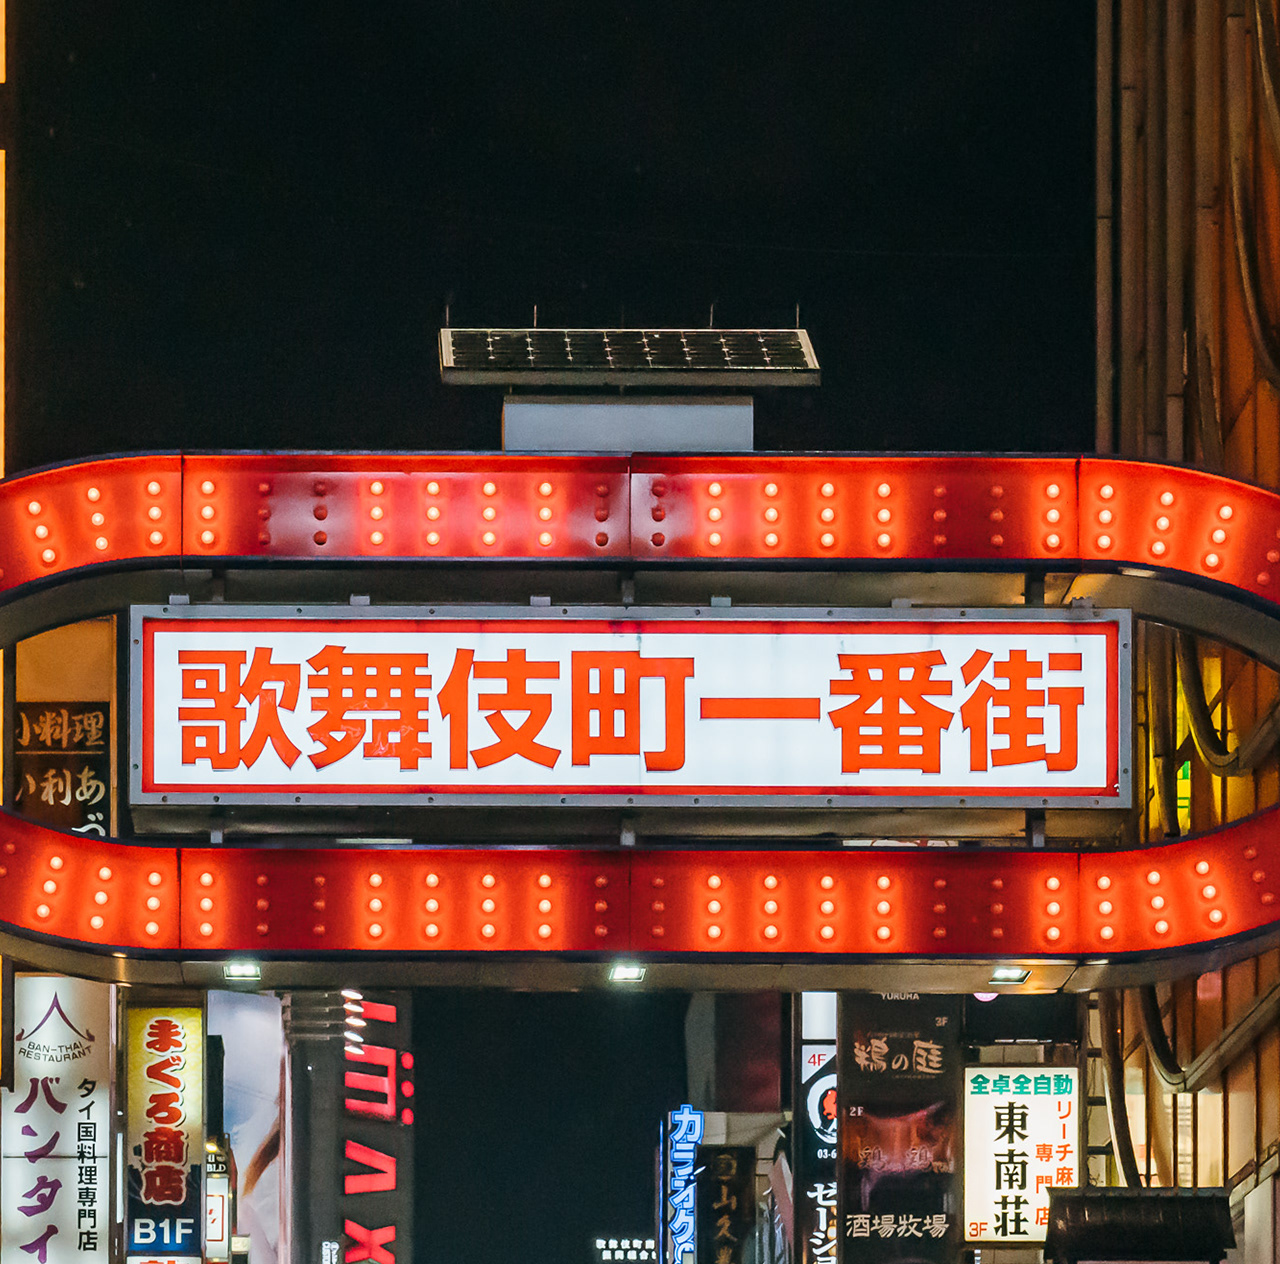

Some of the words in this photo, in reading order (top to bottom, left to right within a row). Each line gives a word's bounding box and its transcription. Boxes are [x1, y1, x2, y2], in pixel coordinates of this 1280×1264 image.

[176, 644, 1087, 774] 歌舞伎町一番街
[935, 1017, 949, 1027] 3F
[17, 1044, 93, 1063] RESTAURANT
[27, 1040, 84, 1054] BAN-THAI
[807, 1053, 827, 1067] 4F
[969, 1073, 1074, 1096] 全卓全自動
[144, 1016, 188, 1206] まぐろ商店
[849, 1106, 864, 1117] 2F
[13, 1076, 68, 1264] バンタイ
[76, 1077, 99, 1253] タイ国料理専門店
[994, 1101, 1030, 1237] 東南荘
[133, 1218, 195, 1245] B1F
[845, 1213, 950, 1239] 酒場牧場
[969, 1222, 988, 1238] 3F
